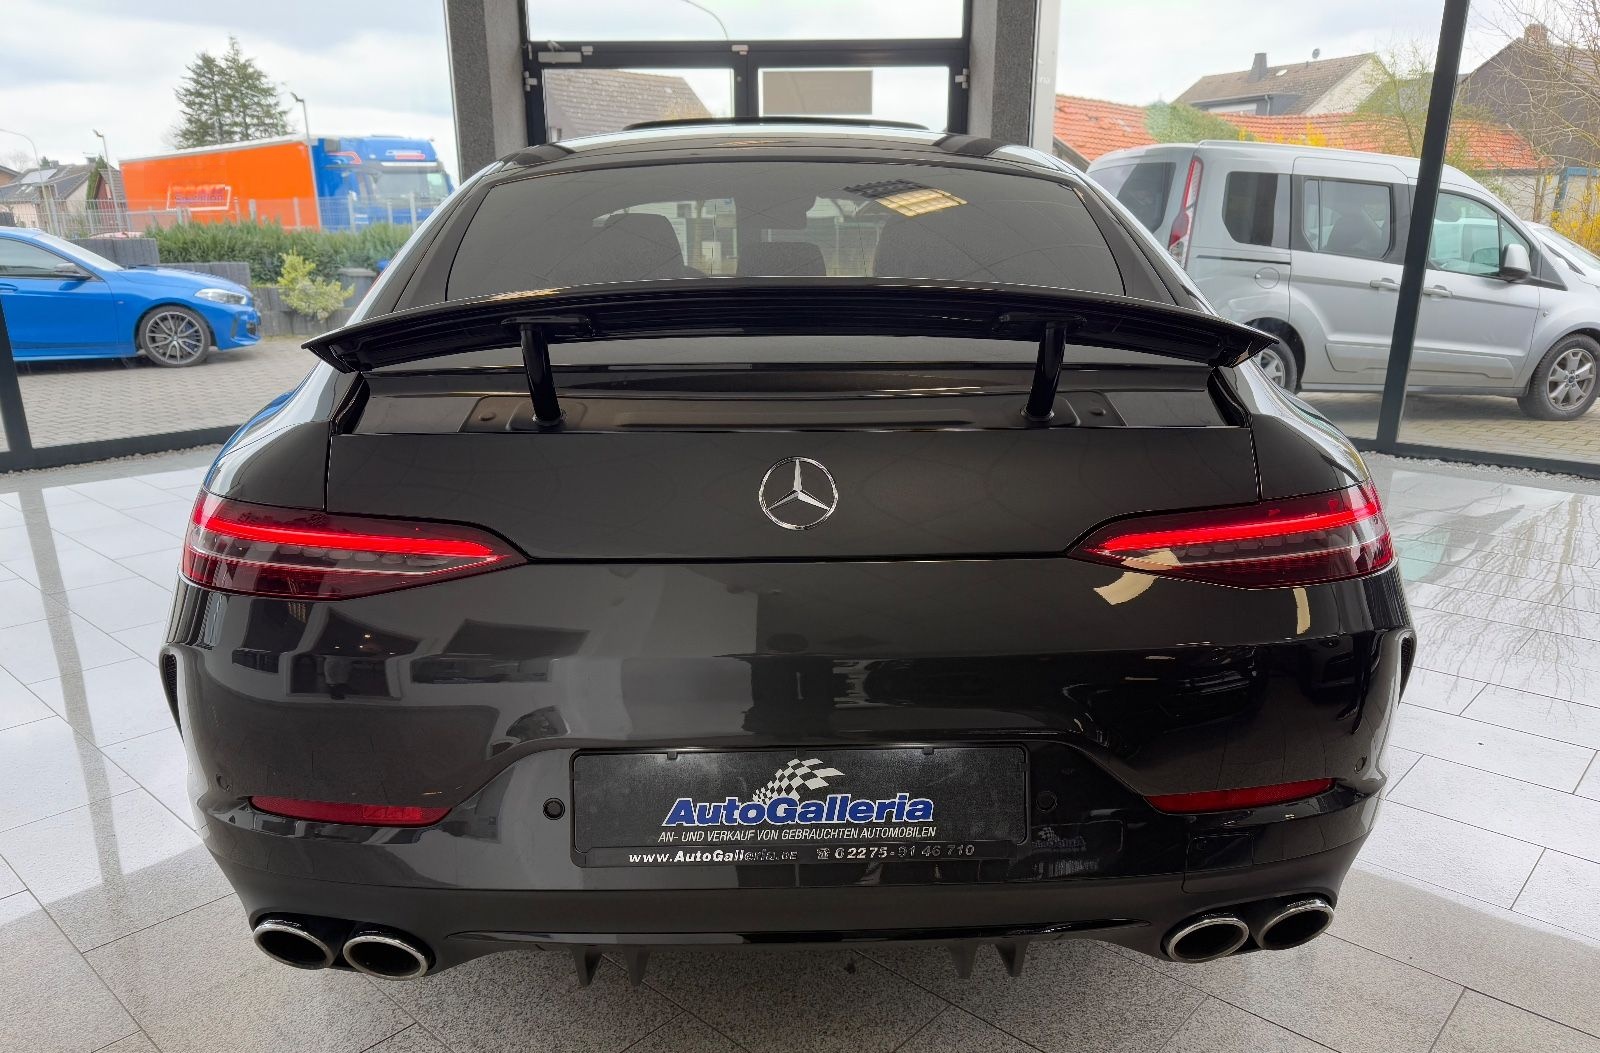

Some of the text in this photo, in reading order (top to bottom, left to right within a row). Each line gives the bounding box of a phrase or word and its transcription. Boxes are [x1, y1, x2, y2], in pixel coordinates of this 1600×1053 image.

[661, 792, 934, 827] AutoGalleria
[658, 826, 937, 843] AN- UND VERKAUF VON GEBRAUCHTEN AUTOMOBILEN
